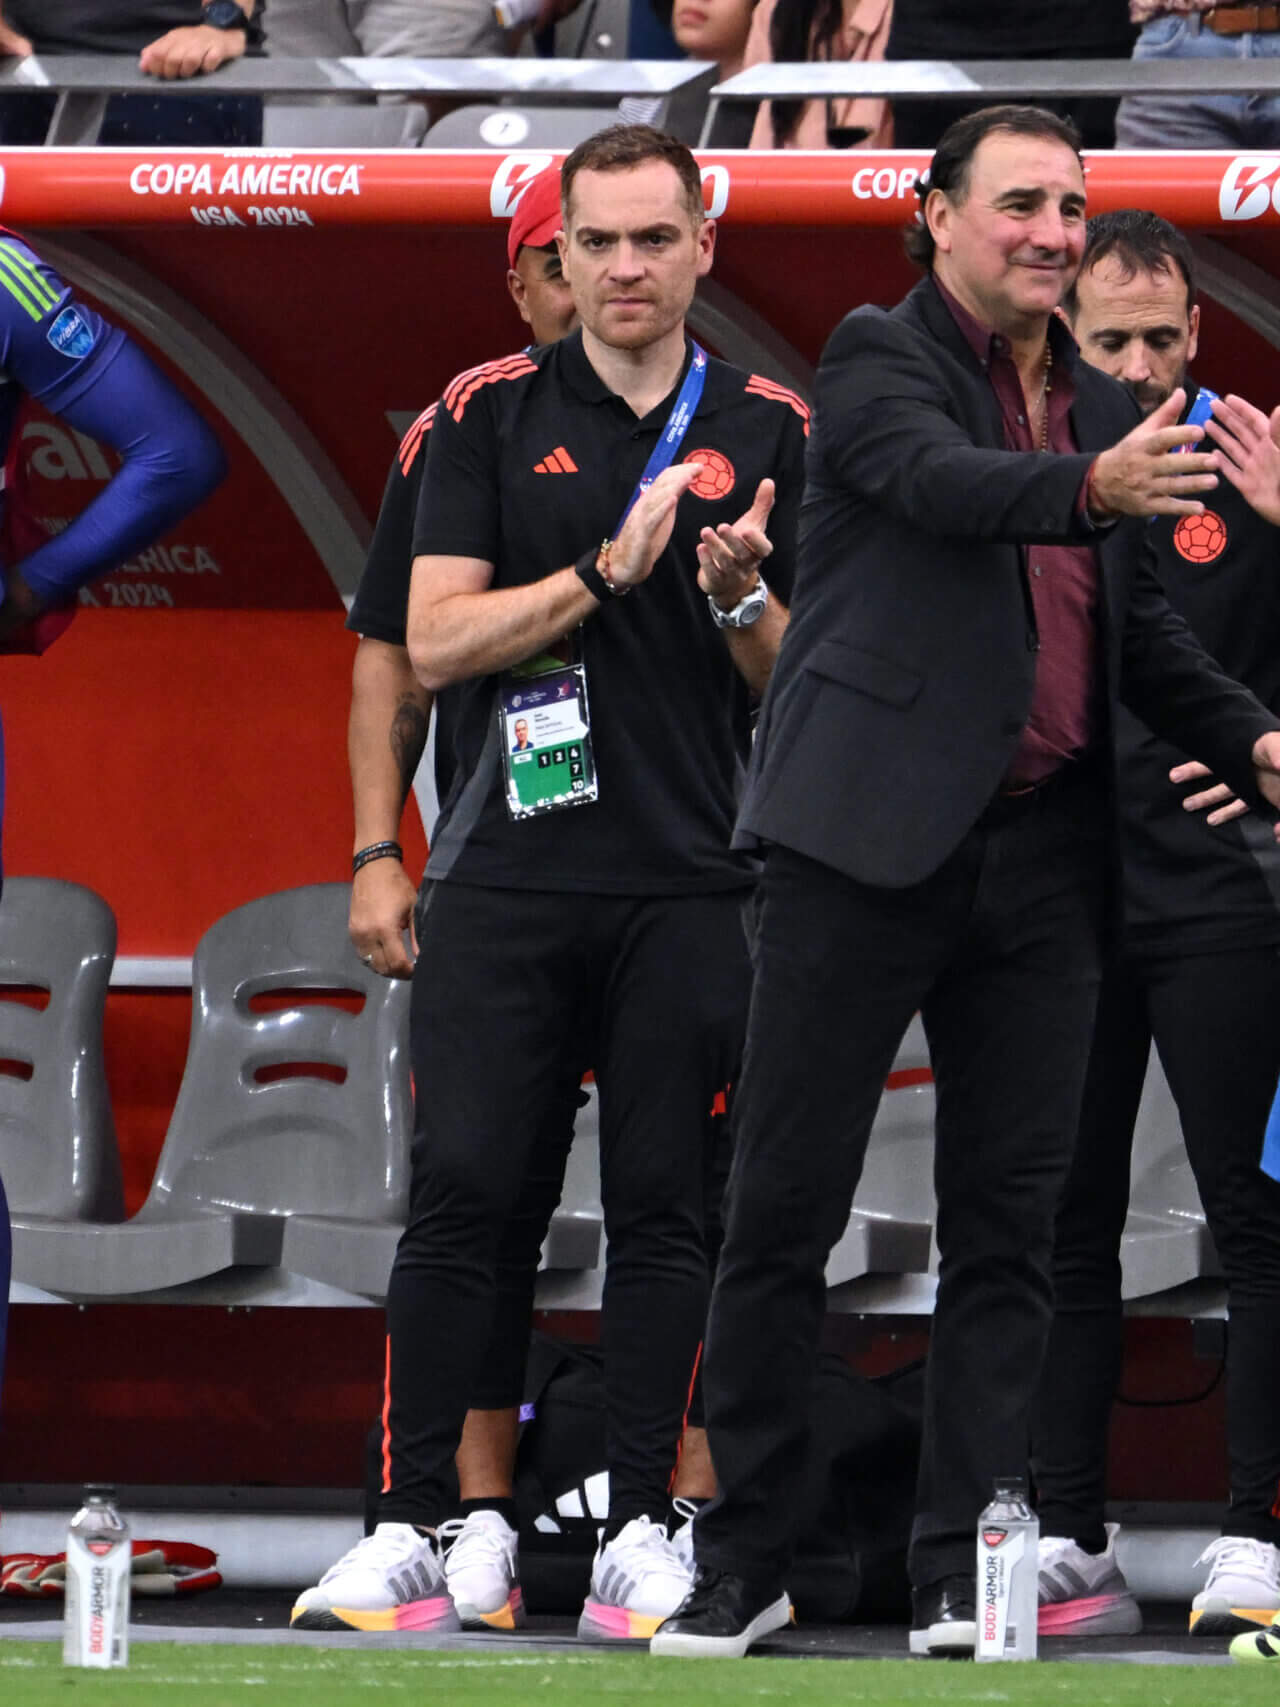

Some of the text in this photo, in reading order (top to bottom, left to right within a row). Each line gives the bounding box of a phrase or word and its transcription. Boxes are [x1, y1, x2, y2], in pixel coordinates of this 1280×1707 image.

[130, 164, 361, 195] COPA AMERICA
[190, 206, 314, 227] USA 2024
[118, 546, 222, 574] RICA
[104, 583, 176, 608] 2024
[984, 1555, 998, 1641] BODYARMOR
